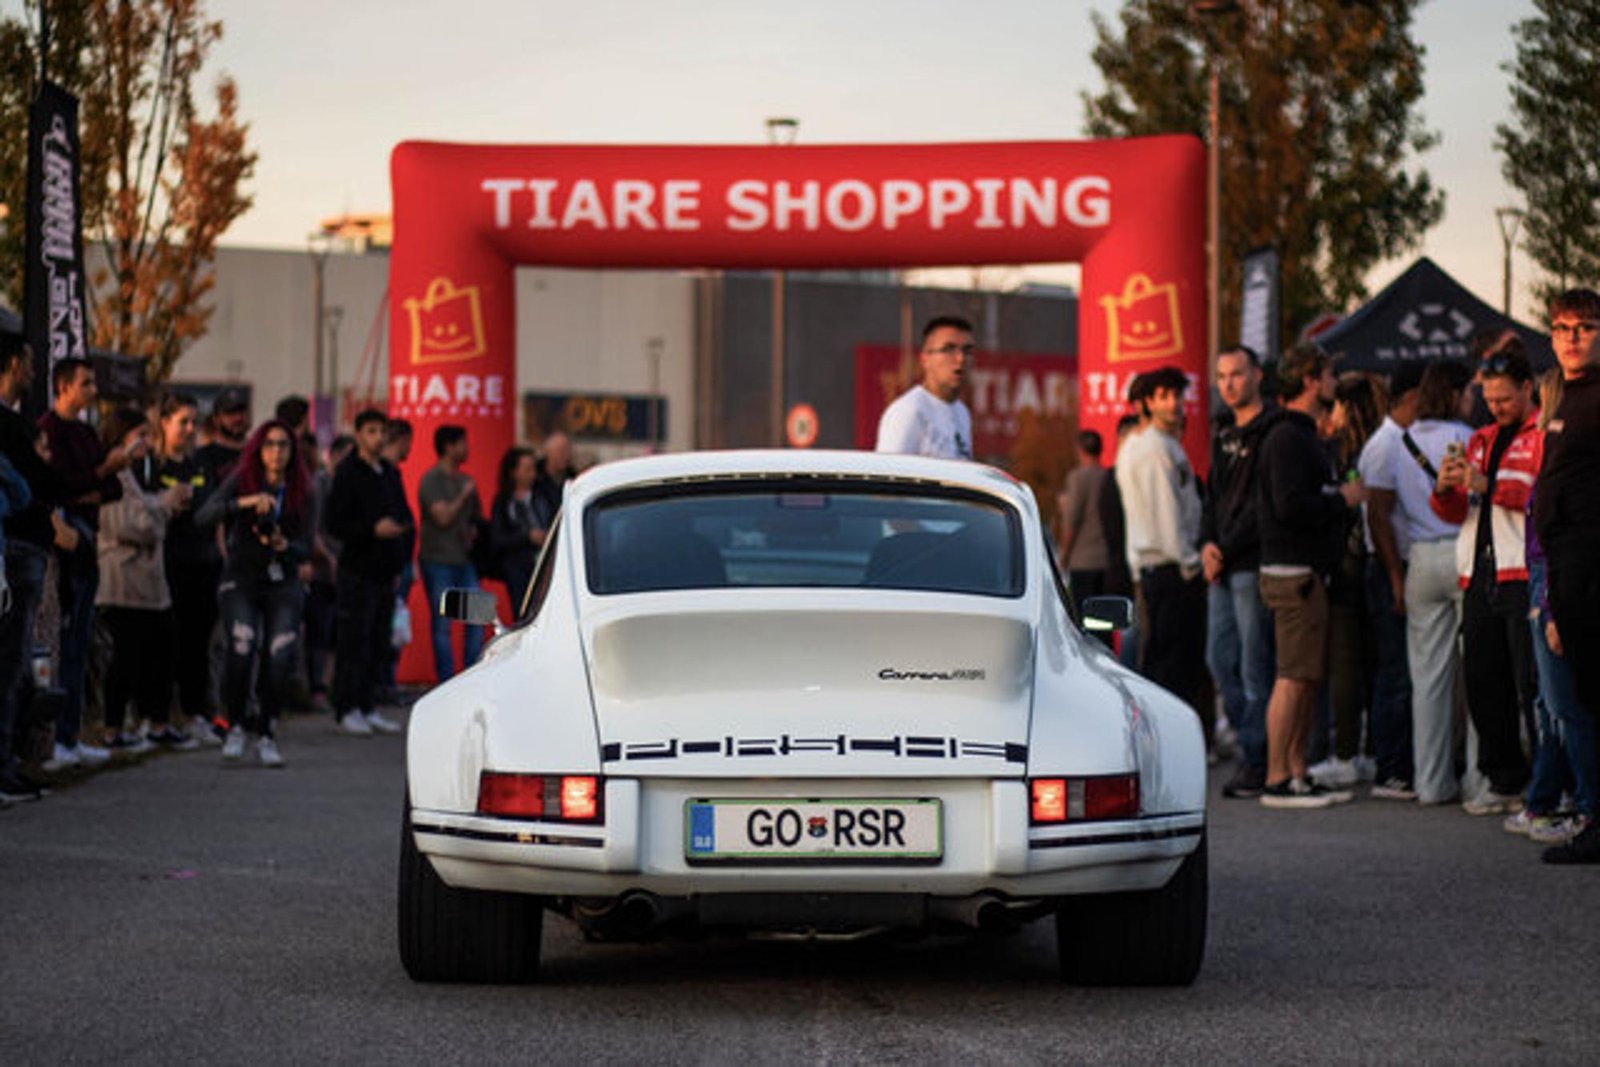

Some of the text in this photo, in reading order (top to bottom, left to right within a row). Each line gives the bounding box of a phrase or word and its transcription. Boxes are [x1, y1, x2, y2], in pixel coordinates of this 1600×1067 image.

[482, 177, 1112, 230] TIARE SHOPPING
[393, 374, 503, 403] TIARE
[567, 397, 626, 432] OVS
[878, 668, 952, 681] Carrera
[747, 808, 905, 847] GO RSR
